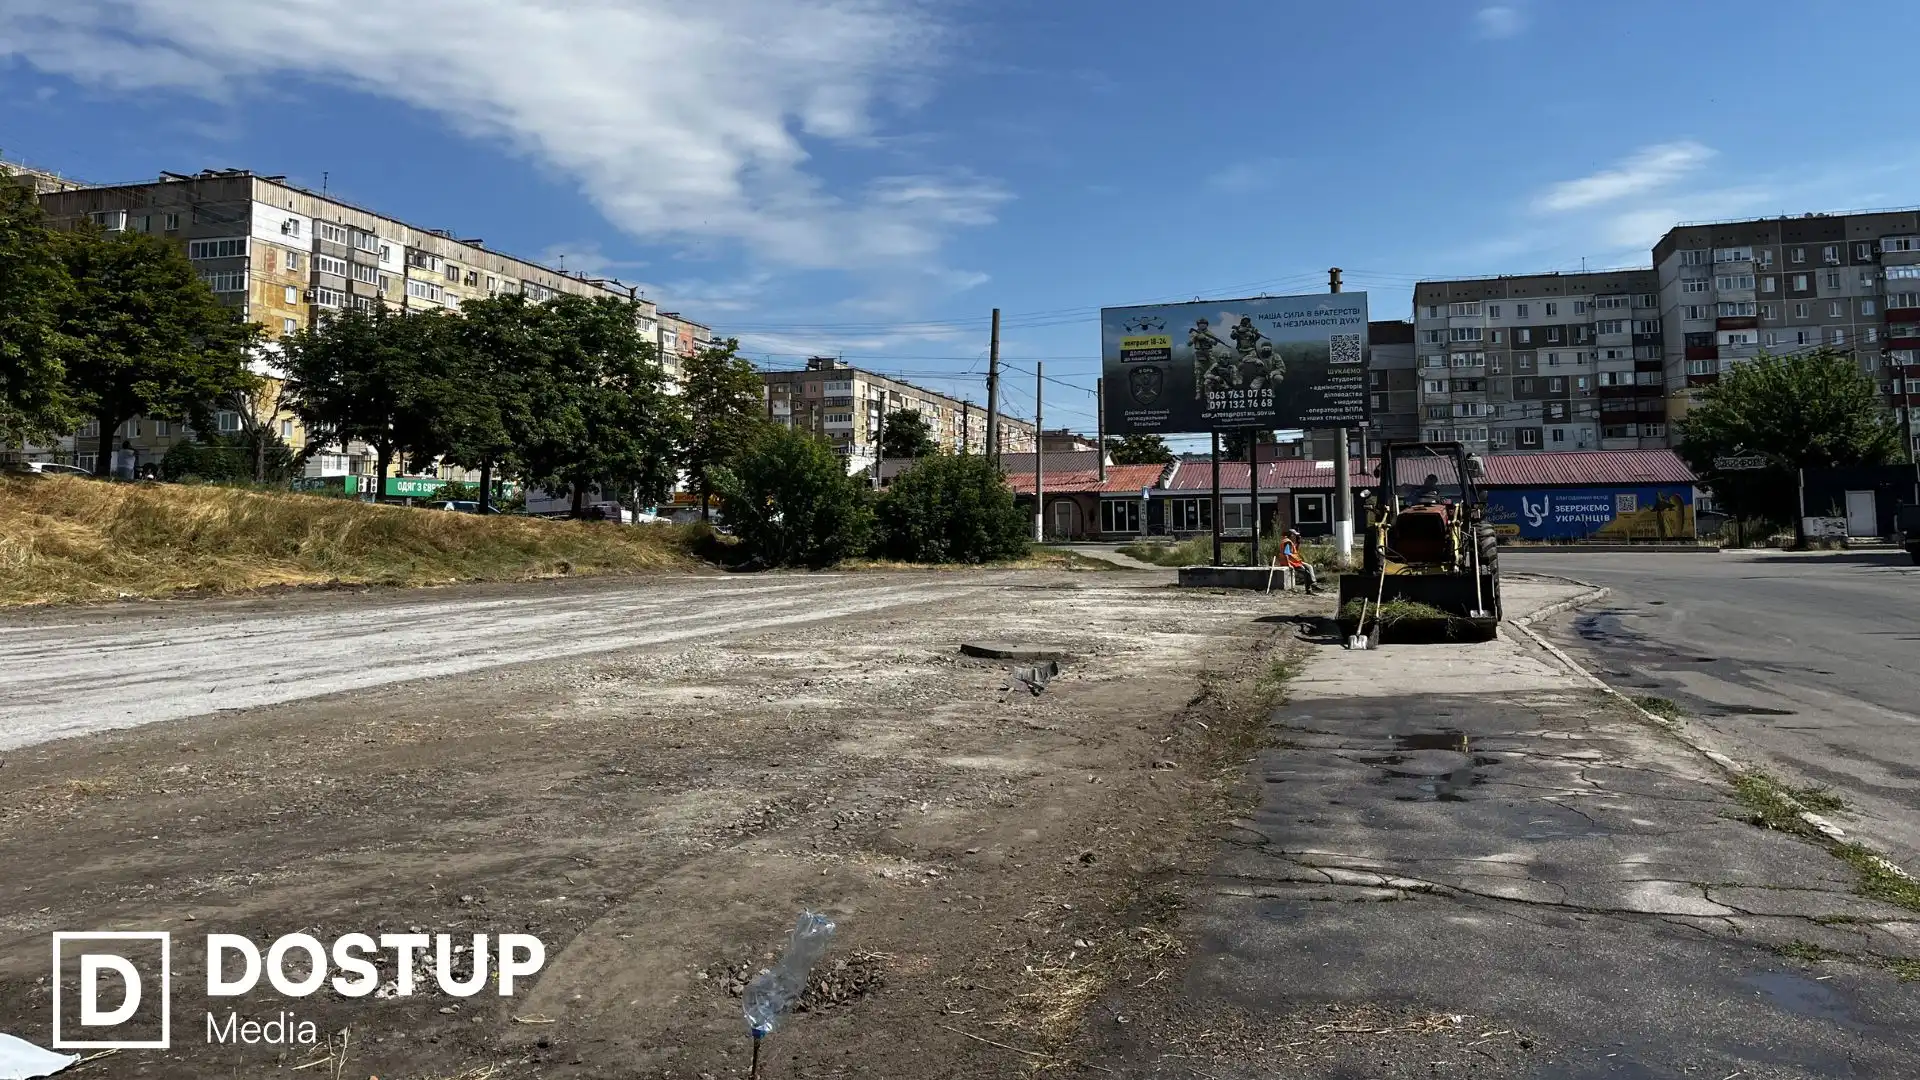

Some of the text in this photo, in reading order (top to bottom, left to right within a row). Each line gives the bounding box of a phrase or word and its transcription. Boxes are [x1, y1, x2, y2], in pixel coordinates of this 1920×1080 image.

[1283, 311, 1305, 319] СИЛА
[1313, 308, 1360, 317] БРАТЕРСТВІ
[1283, 319, 1337, 328] НЕЗЛАМНОСТІ
[1339, 317, 1361, 326] ДУХУ
[1209, 388, 1273, 400] 063 763 07 53
[1209, 398, 1273, 410] 097 132 76 68
[397, 481, 416, 493] ОДЯГ
[417, 482, 422, 491] З
[1555, 504, 1610, 512] ЗБЕРЕЖЕМО
[1555, 513, 1610, 523] УКРАЇНЦІВ
